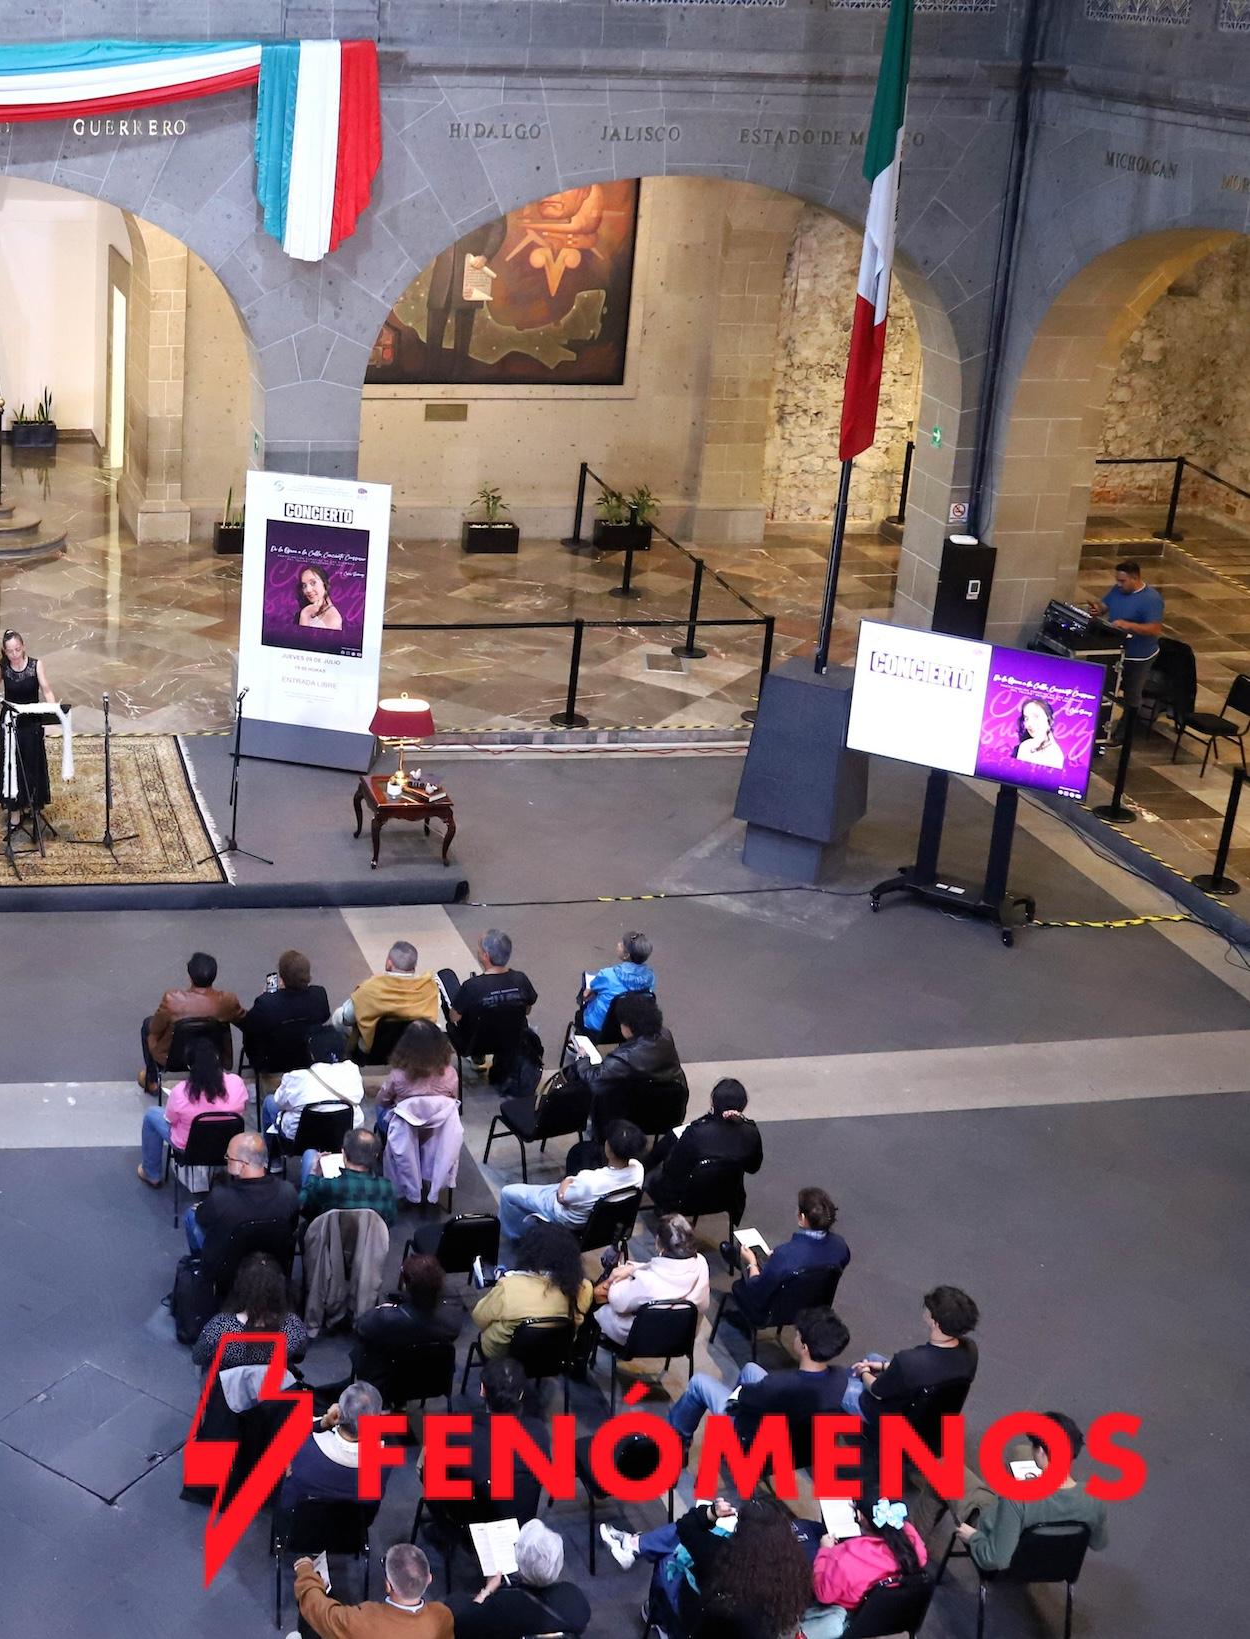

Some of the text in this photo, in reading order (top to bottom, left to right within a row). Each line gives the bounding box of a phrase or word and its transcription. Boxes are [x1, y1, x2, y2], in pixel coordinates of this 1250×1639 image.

[73, 118, 187, 136] GUERRERO
[448, 123, 542, 140] HIDALGO
[600, 125, 681, 142] JALISCO
[739, 128, 815, 145] ESTADO
[821, 130, 845, 146] DE
[1104, 151, 1179, 180] MICHOACAN
[285, 503, 353, 524] CONCIERTO
[870, 651, 974, 691] CONCIERTO
